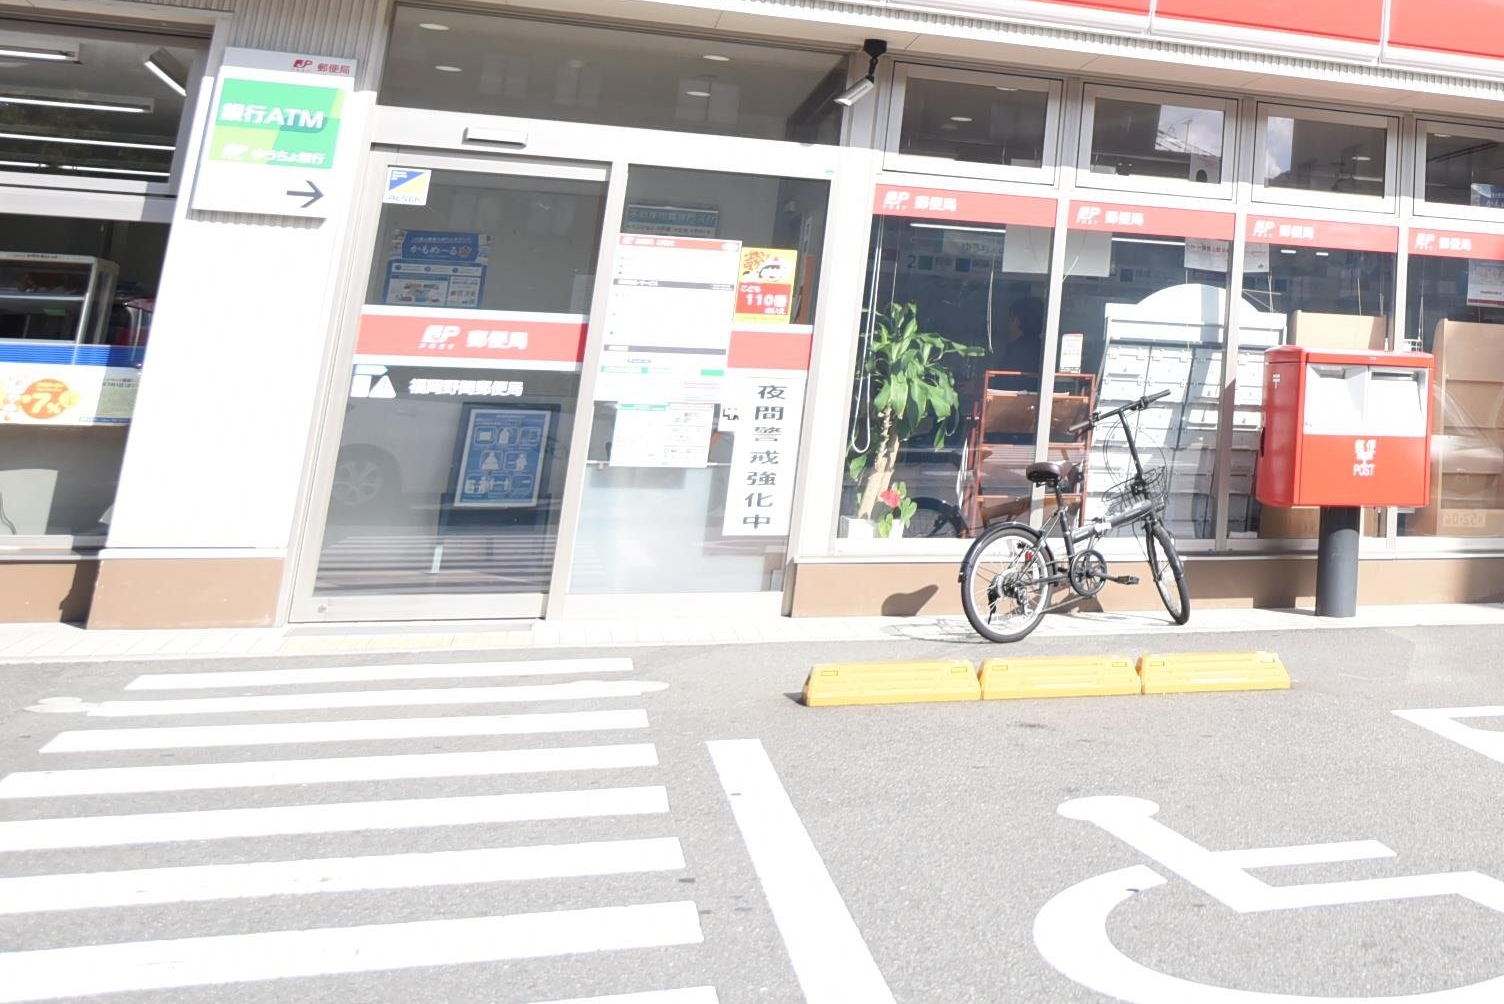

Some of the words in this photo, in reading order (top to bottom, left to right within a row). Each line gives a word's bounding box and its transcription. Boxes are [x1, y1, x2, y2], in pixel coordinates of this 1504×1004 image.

[317, 63, 350, 75] 郵便局
[219, 102, 325, 129] 銀行ATM
[742, 384, 788, 530] 夜間警戒強化中
[1353, 463, 1376, 477] POST
